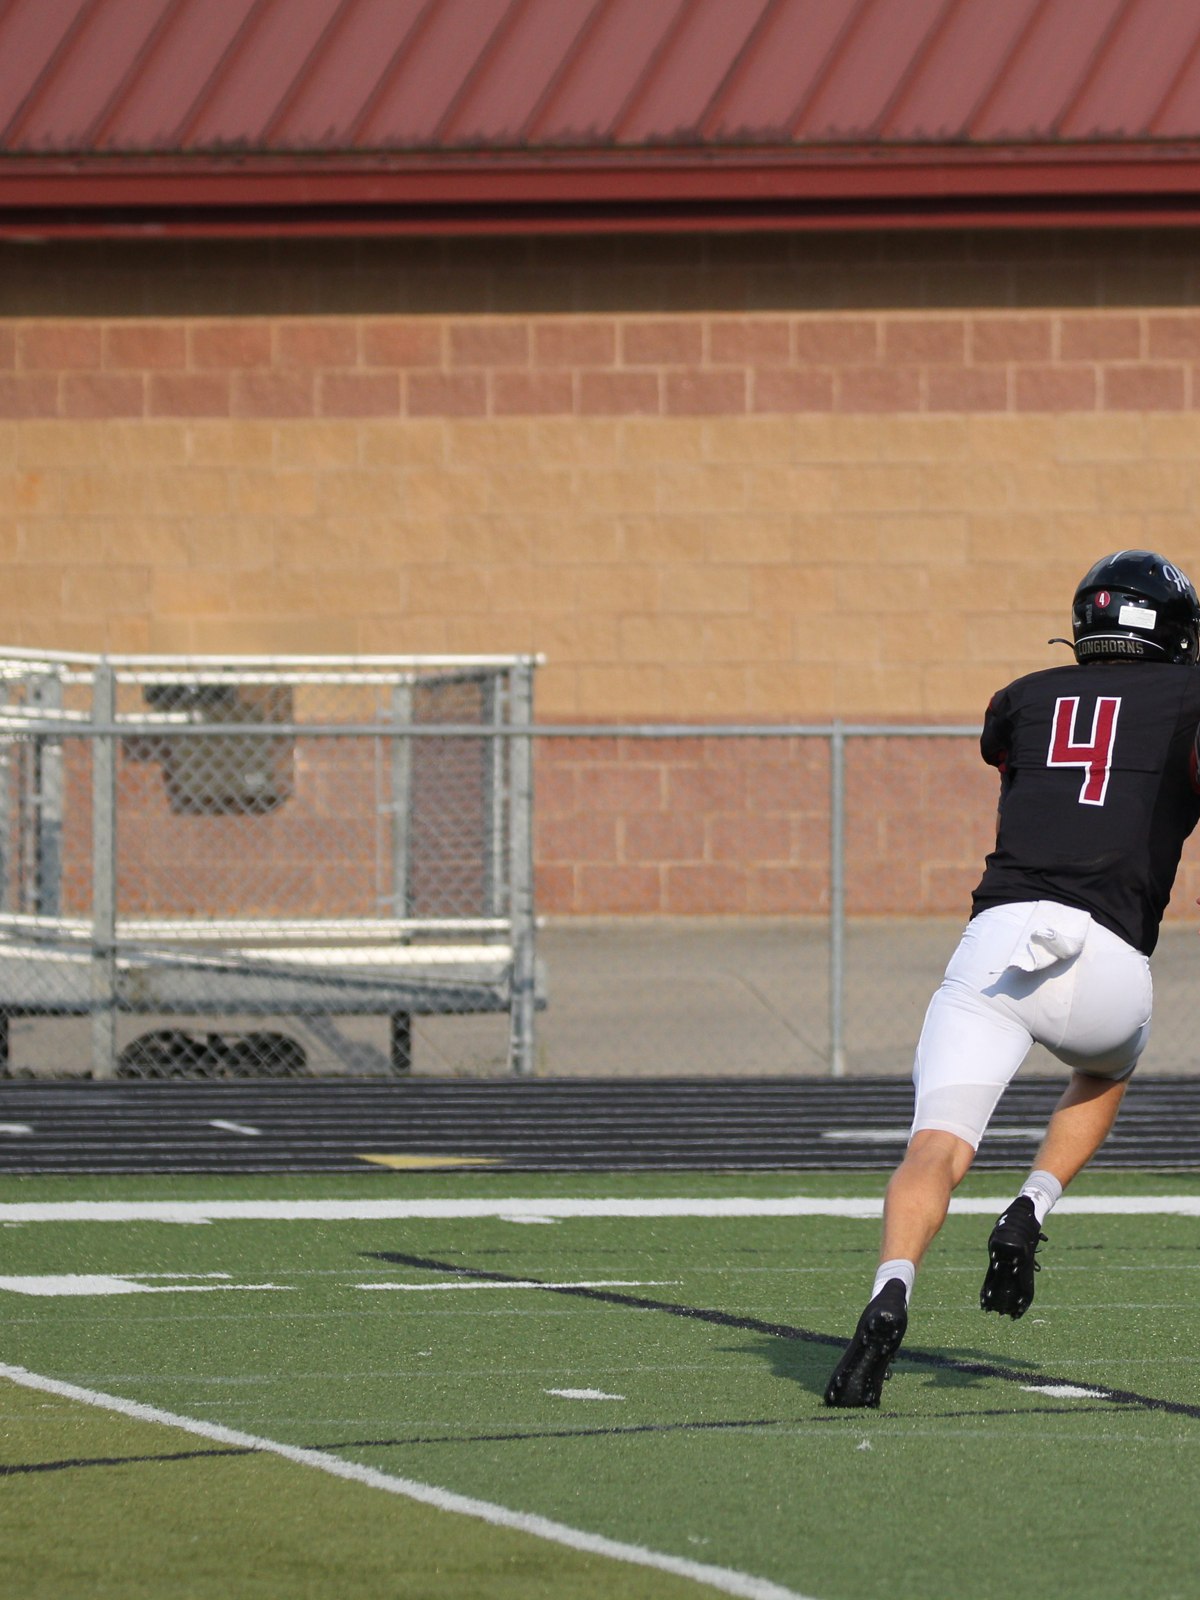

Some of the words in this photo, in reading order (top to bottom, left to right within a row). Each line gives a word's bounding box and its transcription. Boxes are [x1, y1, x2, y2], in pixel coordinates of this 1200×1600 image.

[1098, 592, 1105, 606] 4
[1078, 640, 1144, 656] LONGHORNS
[1046, 696, 1122, 807] 4
